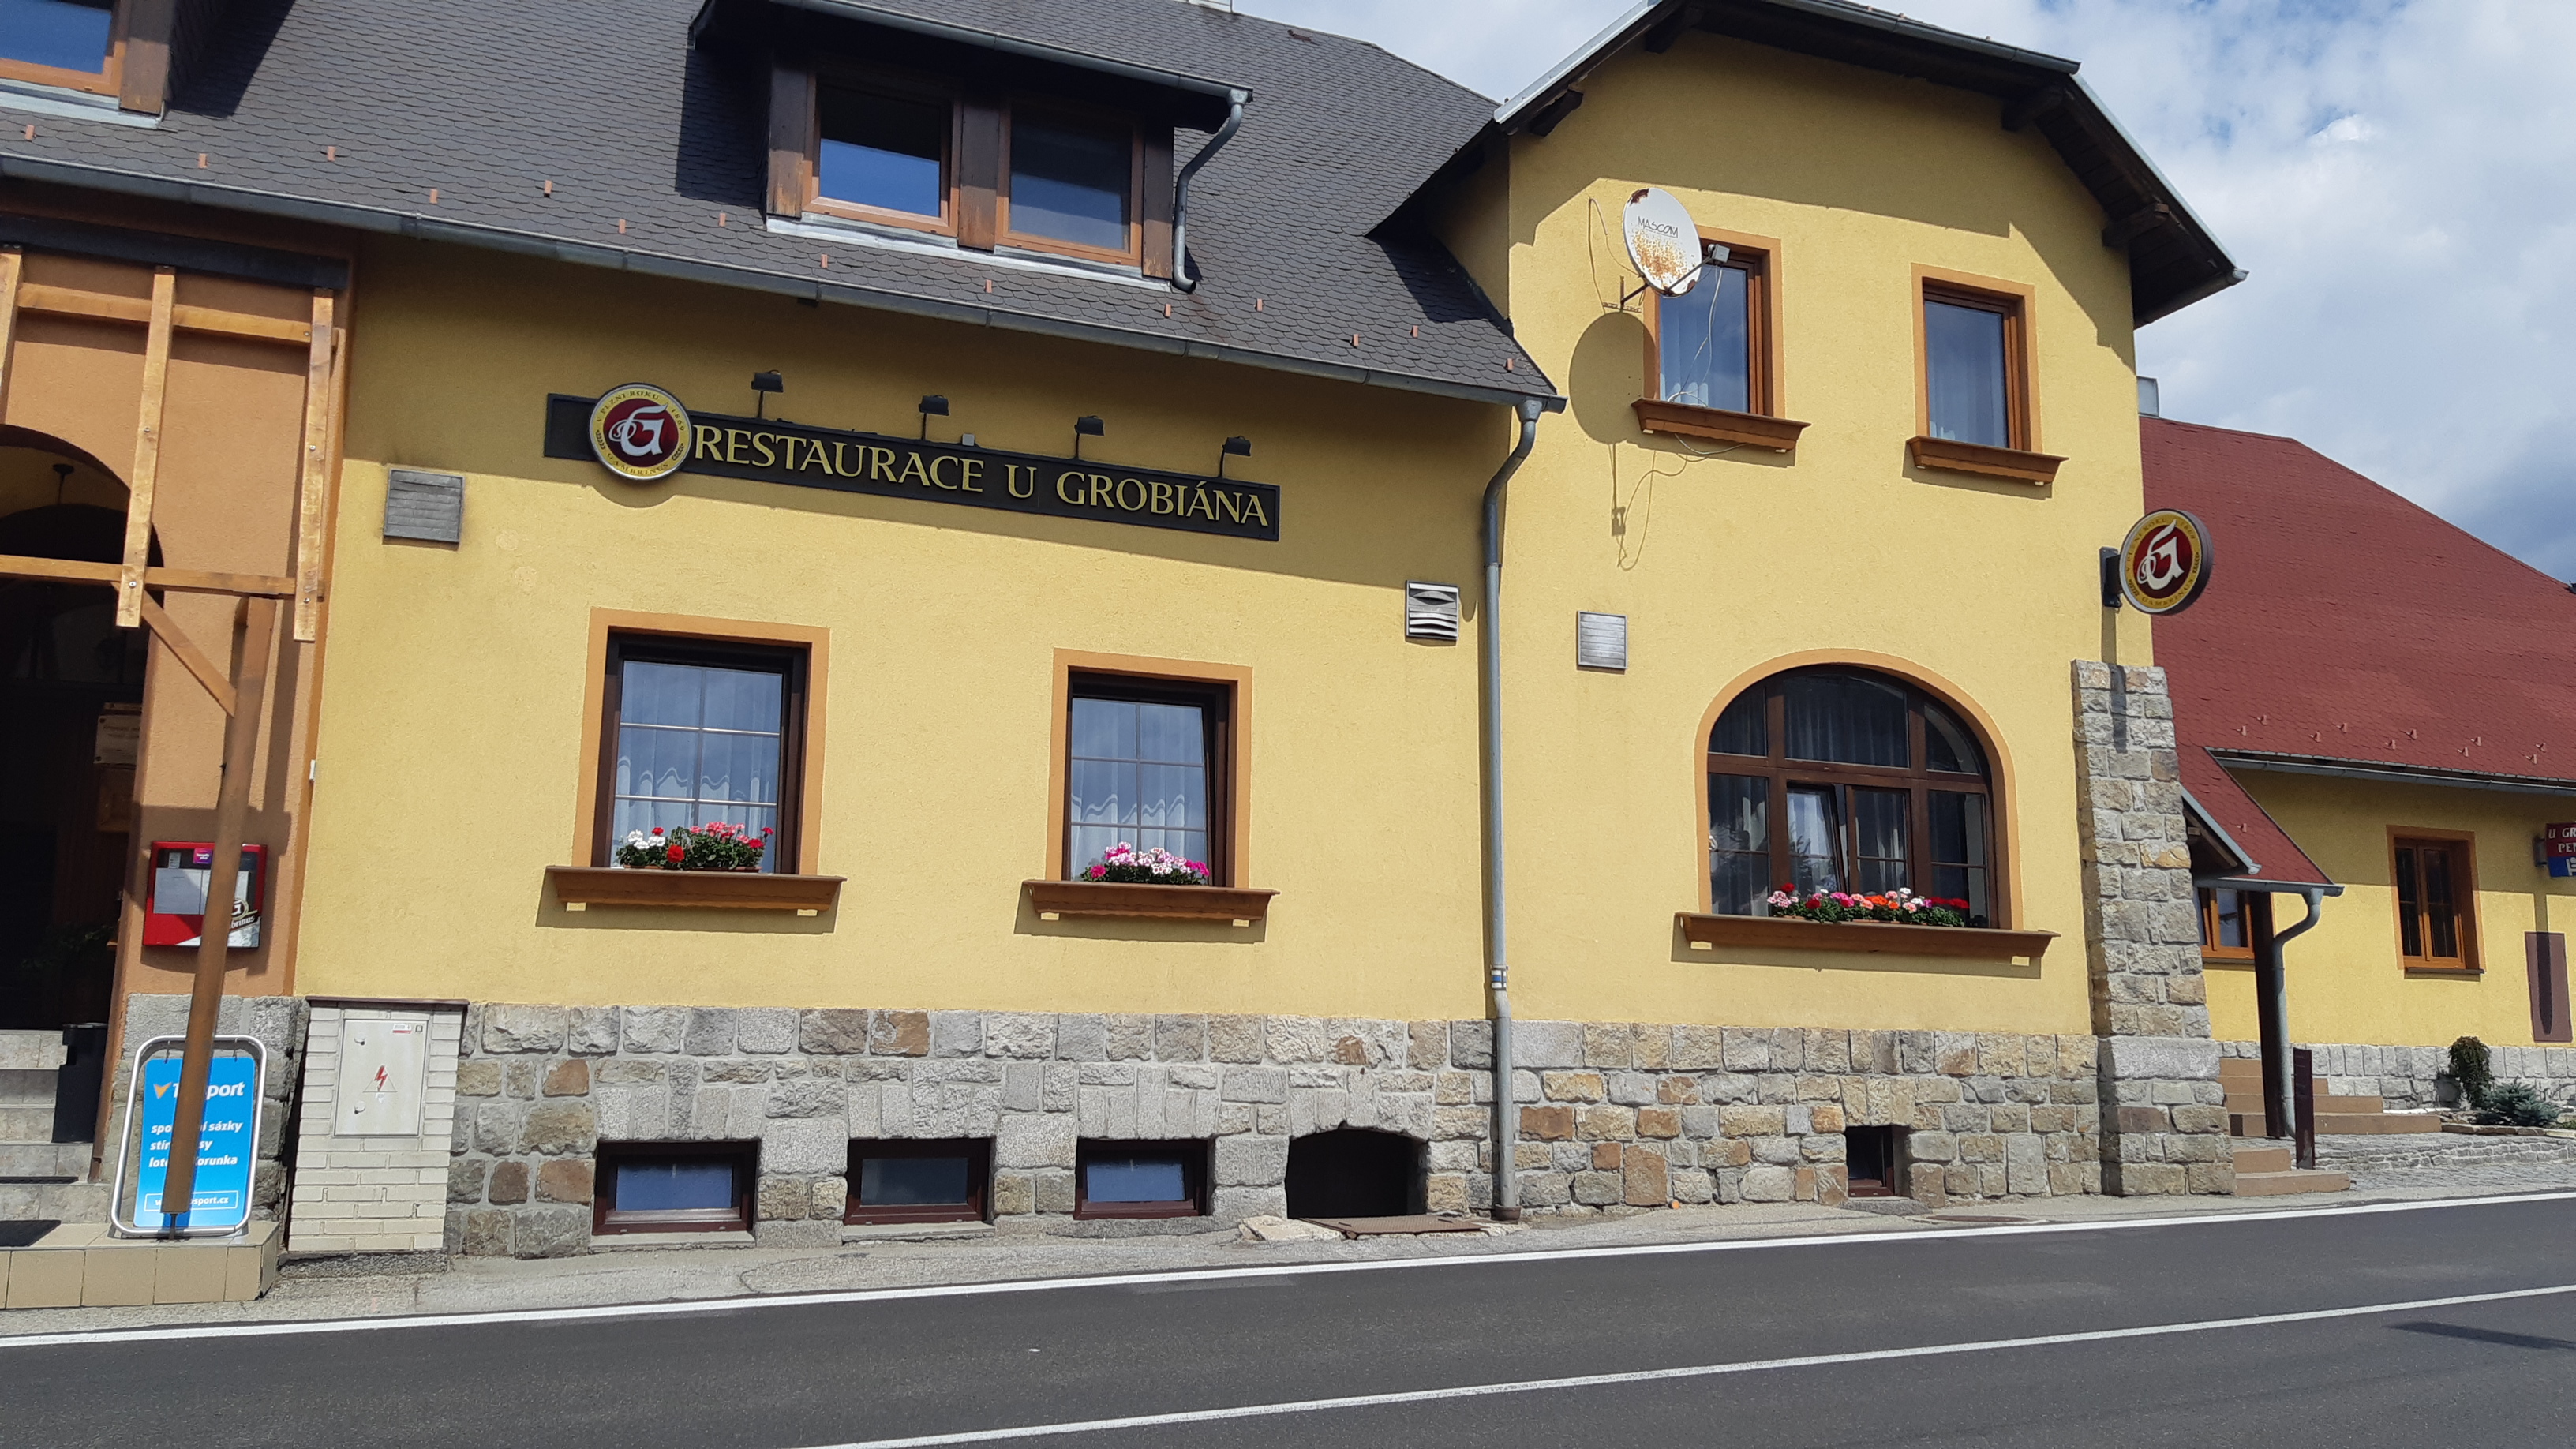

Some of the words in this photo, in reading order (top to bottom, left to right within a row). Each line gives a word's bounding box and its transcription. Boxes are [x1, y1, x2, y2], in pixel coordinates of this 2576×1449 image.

[1638, 216, 1679, 239] MASCOM
[630, 391, 660, 400] ROKU
[607, 453, 668, 475] GAMBRINUS
[692, 425, 984, 492] RESTAURACE
[1005, 464, 1037, 498] U
[1056, 471, 1268, 526] GROBIÁNA
[2548, 829, 2556, 839] U
[208, 1121, 243, 1133] sázky
[195, 1155, 238, 1165] orunka
